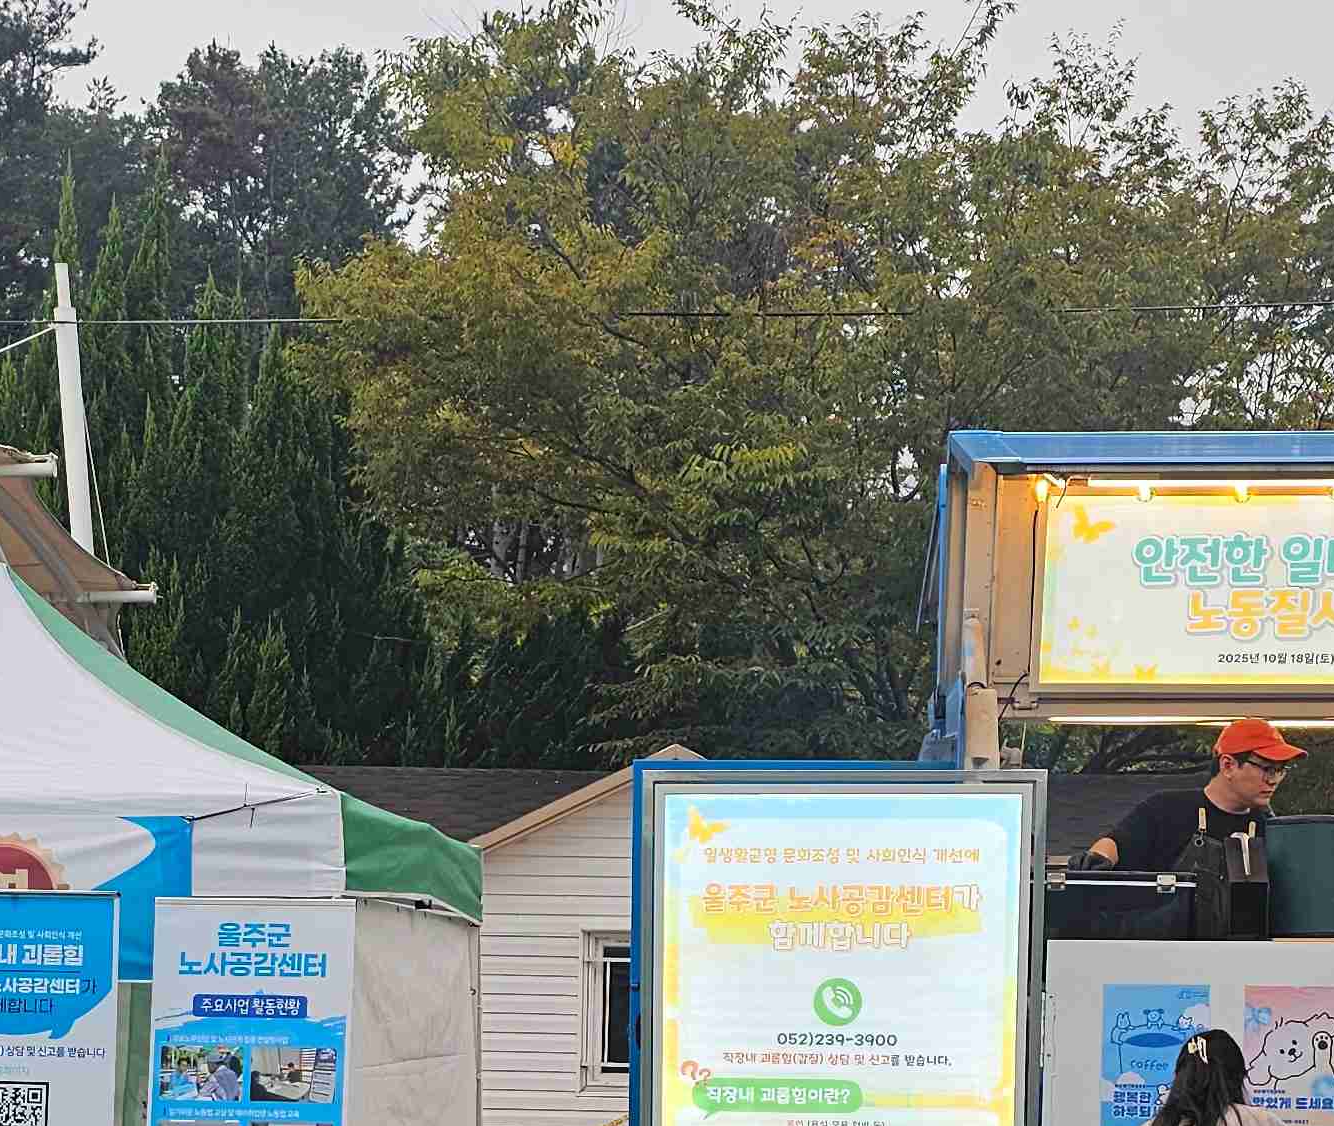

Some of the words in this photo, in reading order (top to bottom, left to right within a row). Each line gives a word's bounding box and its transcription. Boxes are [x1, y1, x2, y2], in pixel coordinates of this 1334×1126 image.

[1132, 534, 1271, 589] 안전한
[1218, 652, 1260, 665] 2025년
[1263, 652, 1288, 665] 10월
[1290, 652, 1334, 666] 18일(토)
[781, 846, 839, 864] 문화조성
[845, 846, 861, 864] 및
[866, 846, 927, 864] 사회인식
[933, 846, 981, 864] 개선에
[701, 882, 779, 914] 울주군
[786, 882, 981, 916] 노사공감센터가
[217, 922, 291, 948] 울주군
[769, 920, 912, 952] 함께합니다
[22, 943, 84, 967] 괴롭힘
[178, 951, 327, 978] 노사공감센터
[201, 999, 249, 1016] 주요사업
[252, 999, 301, 1017] 활동현황
[776, 1031, 898, 1047] 052)239-3900
[6, 1045, 24, 1058] 상담
[26, 1046, 37, 1058] 및
[37, 1046, 66, 1058] 신고를
[67, 1047, 106, 1060] 받습니다
[723, 1051, 756, 1065] 직장내
[827, 1052, 851, 1066] 상담
[854, 1052, 865, 1066] 및
[869, 1052, 901, 1067] 신고를
[904, 1052, 953, 1068] 받습니다.
[706, 1085, 755, 1106] 직장내
[760, 1086, 850, 1106] 괴롭힘이란?
